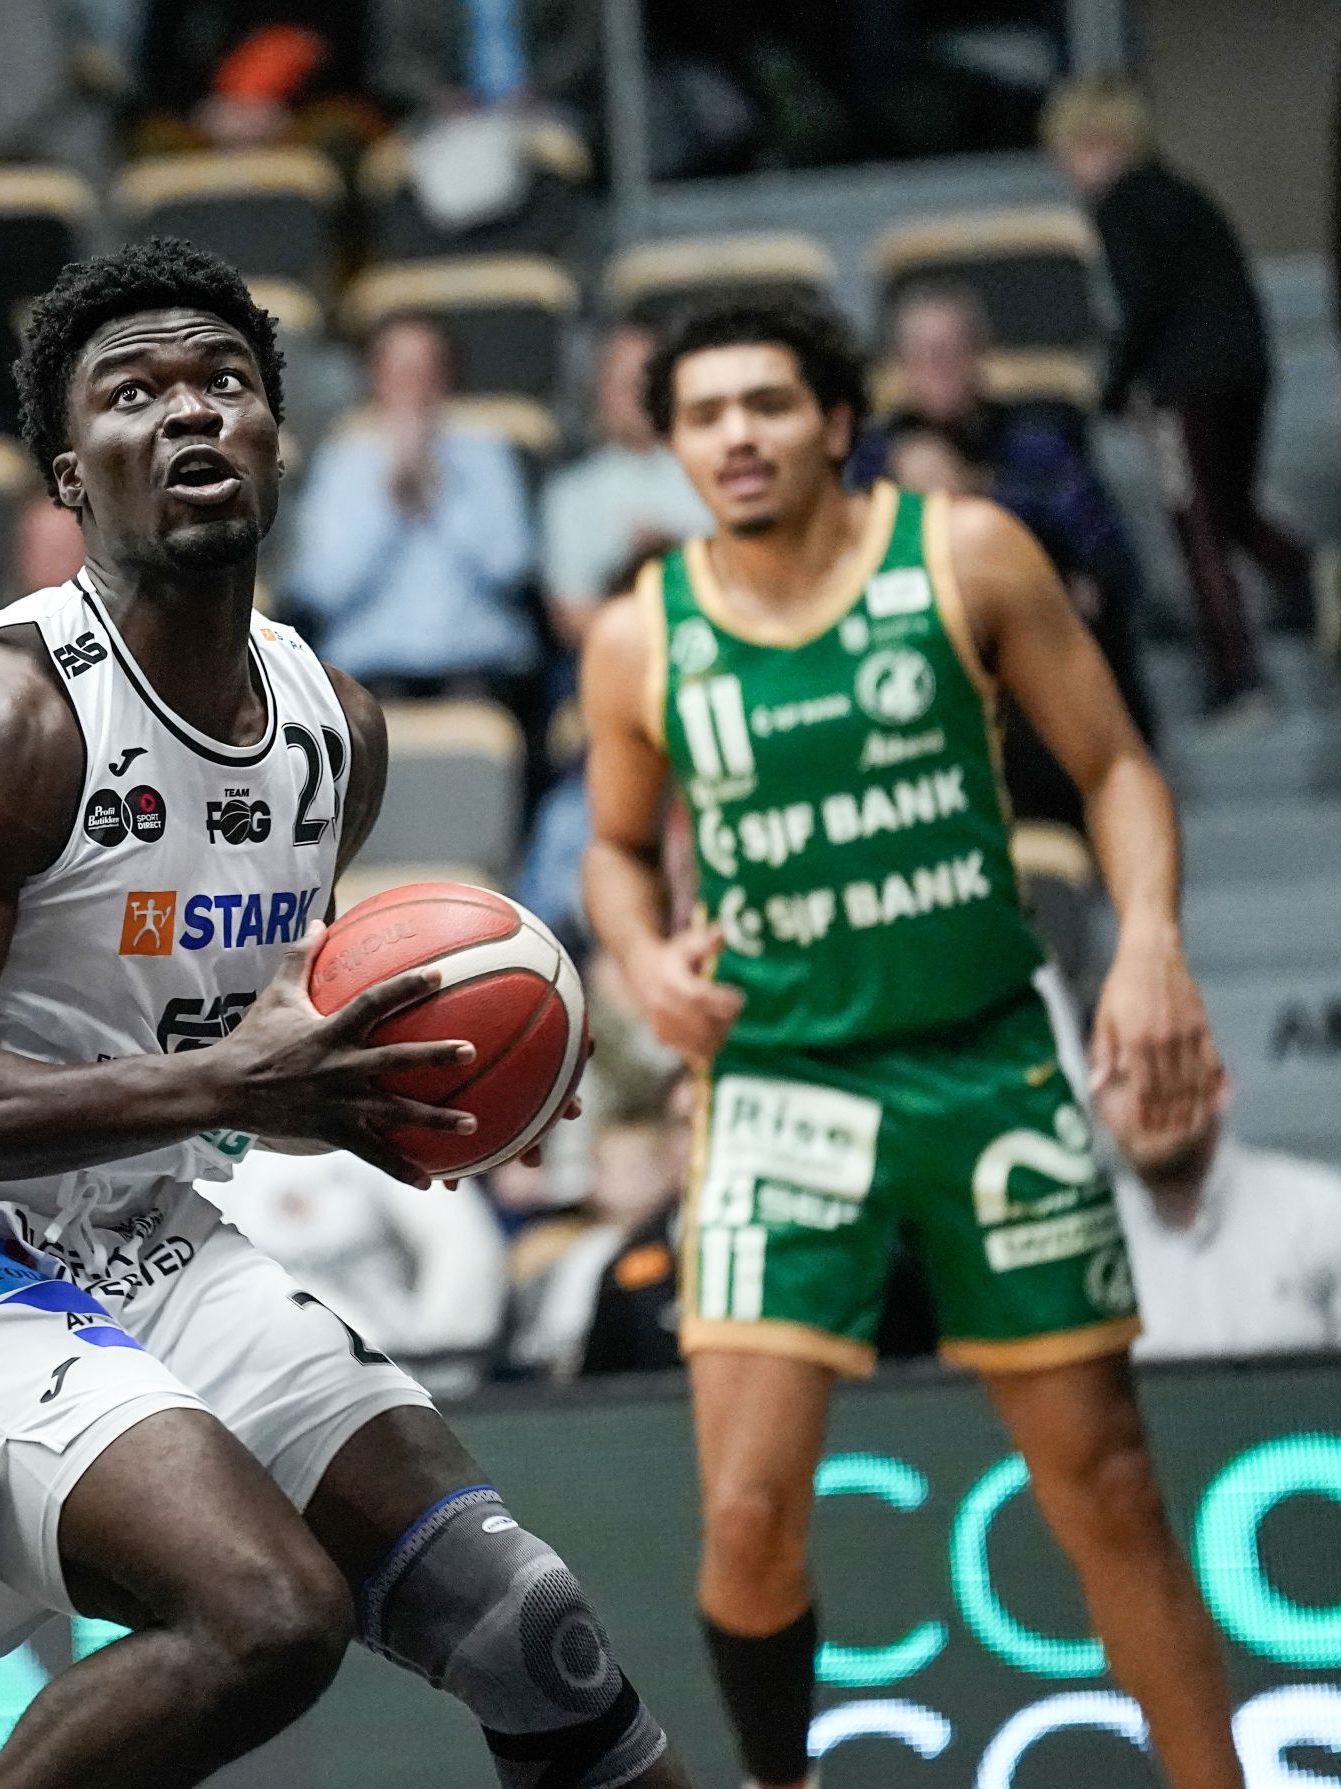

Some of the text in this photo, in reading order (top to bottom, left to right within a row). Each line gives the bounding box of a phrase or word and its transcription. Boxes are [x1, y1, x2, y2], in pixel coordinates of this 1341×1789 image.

[224, 788, 250, 797] TEAM
[821, 764, 968, 845] BANK
[95, 806, 115, 817] Profil
[137, 813, 159, 822] SPORT
[137, 821, 161, 829] DIRECT
[842, 848, 990, 929] BANK
[179, 886, 321, 950] STARK
